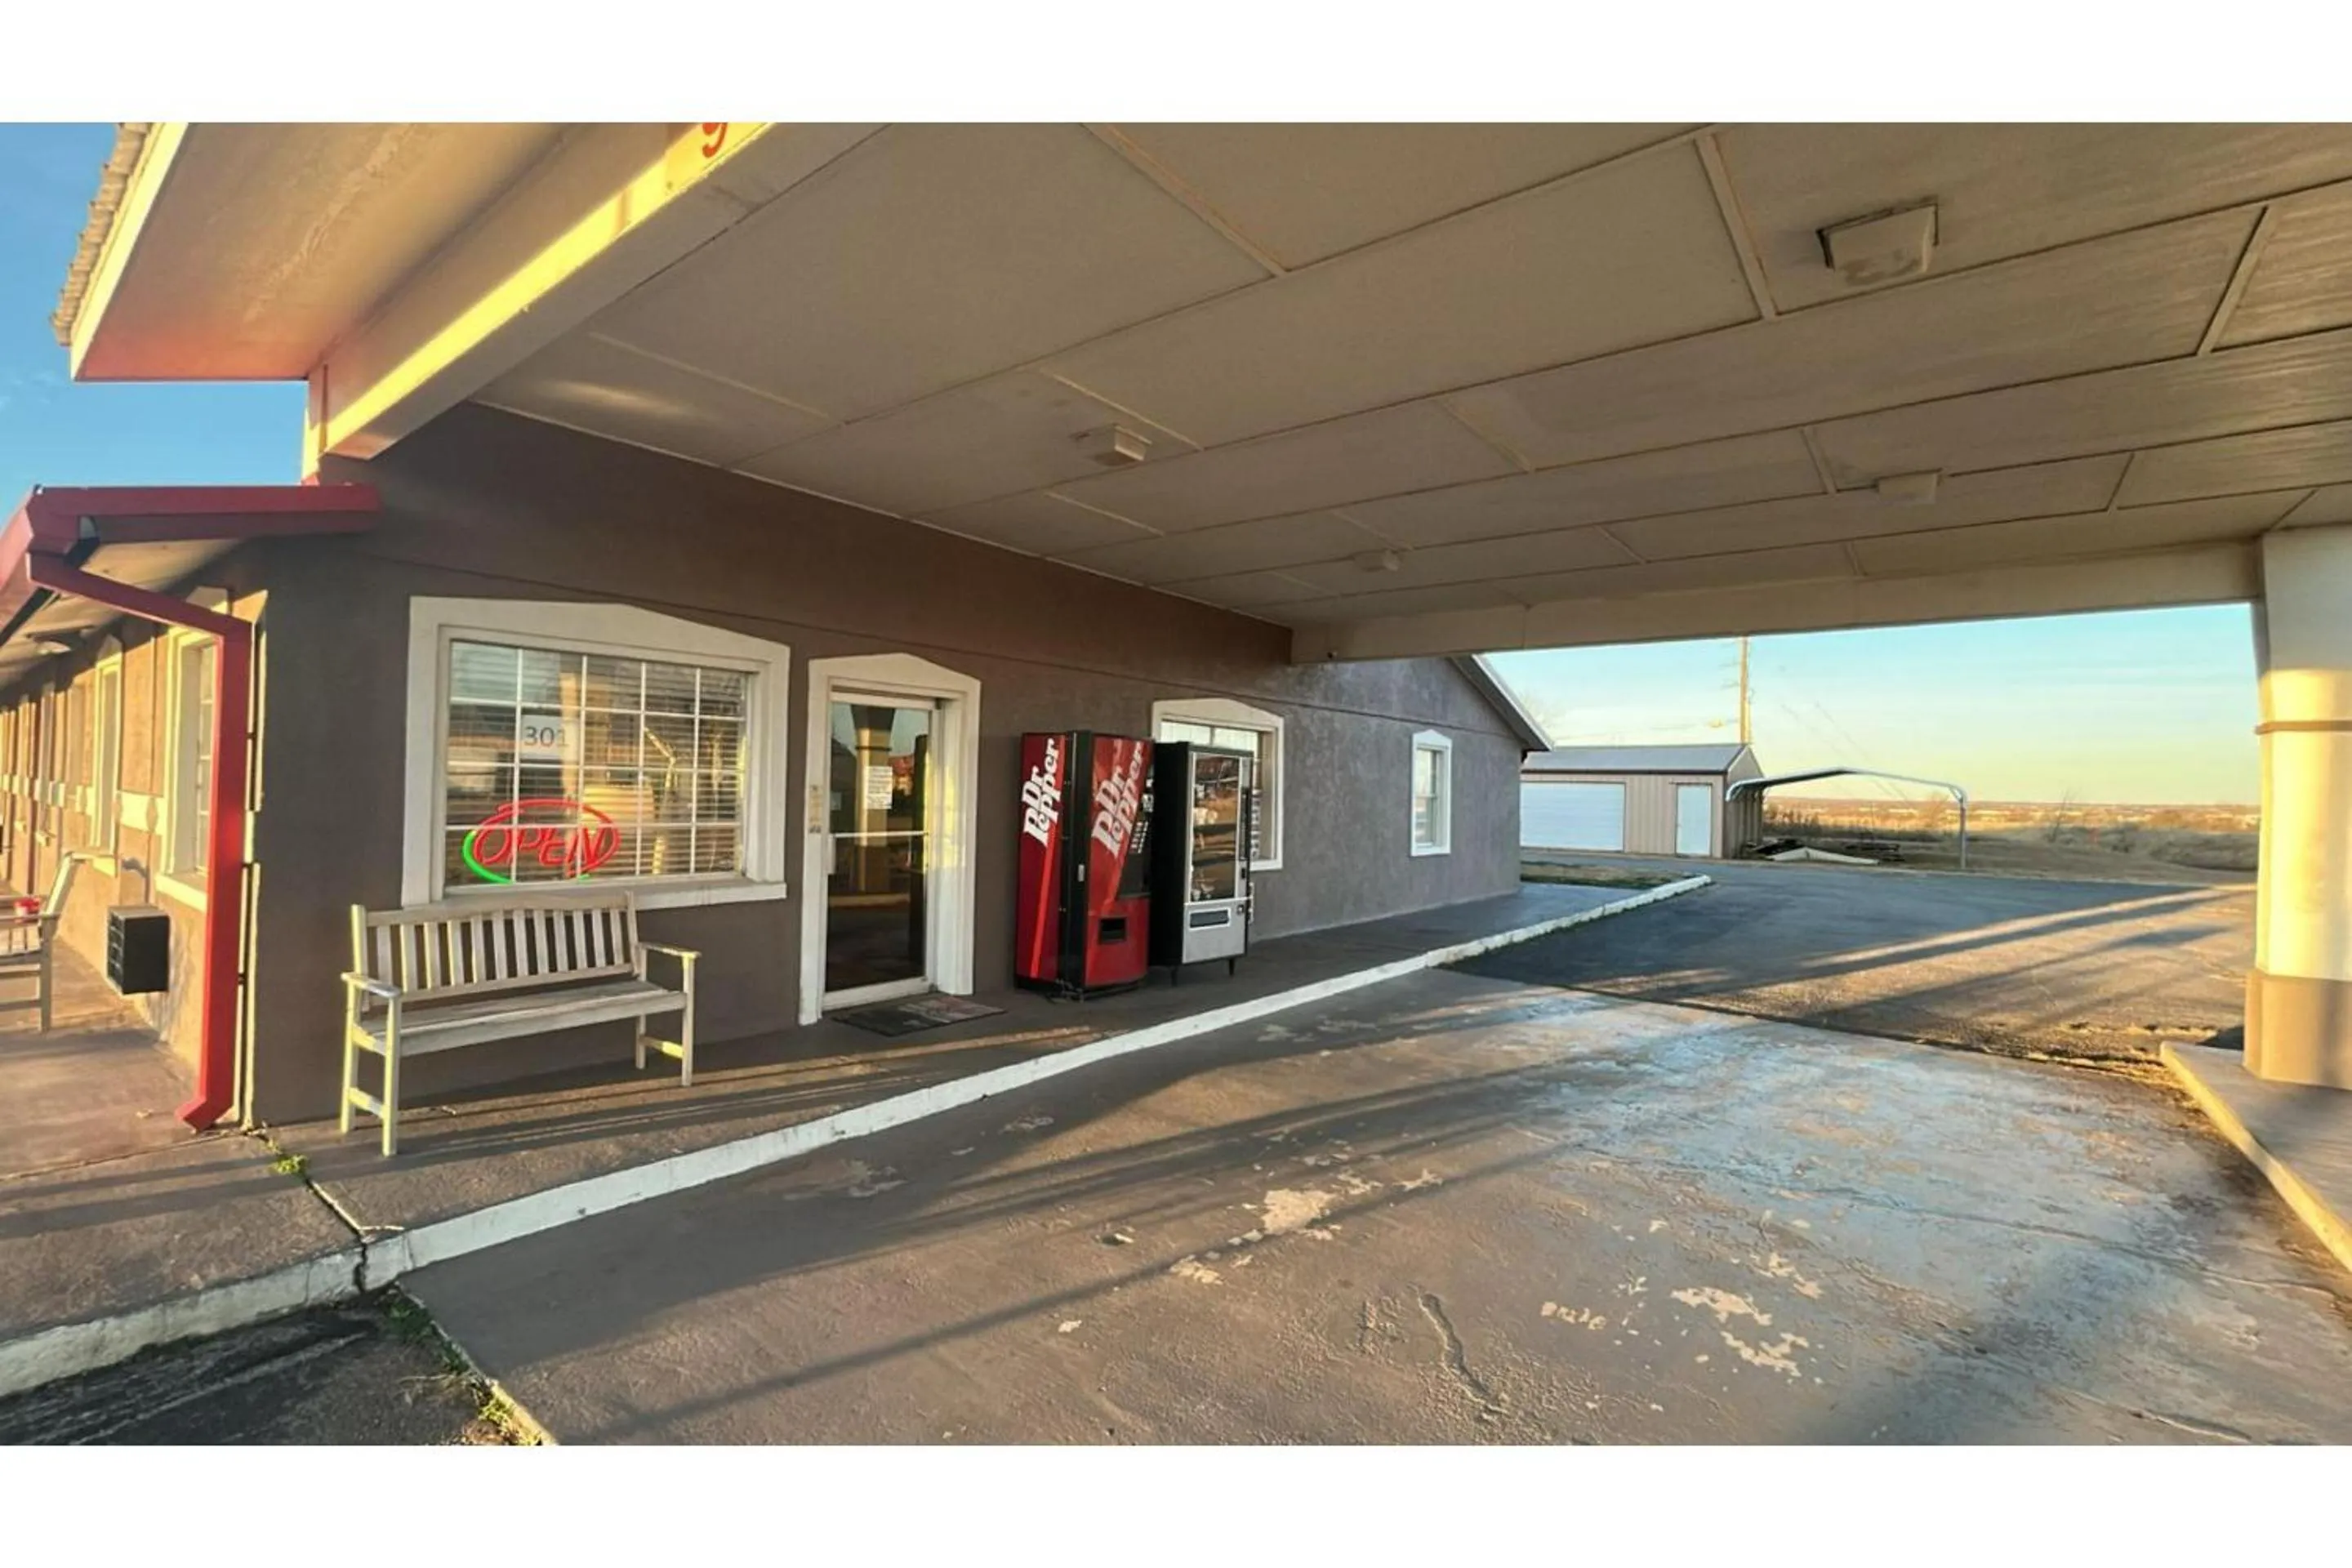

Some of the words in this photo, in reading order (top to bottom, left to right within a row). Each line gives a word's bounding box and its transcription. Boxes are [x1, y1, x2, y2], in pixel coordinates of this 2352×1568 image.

[523, 725, 570, 748] 301
[1022, 765, 1045, 812] Dr
[1023, 737, 1061, 848] Pepper
[1091, 741, 1143, 858] Pepper
[1095, 765, 1125, 815] Dr
[474, 823, 607, 866] OPEN
